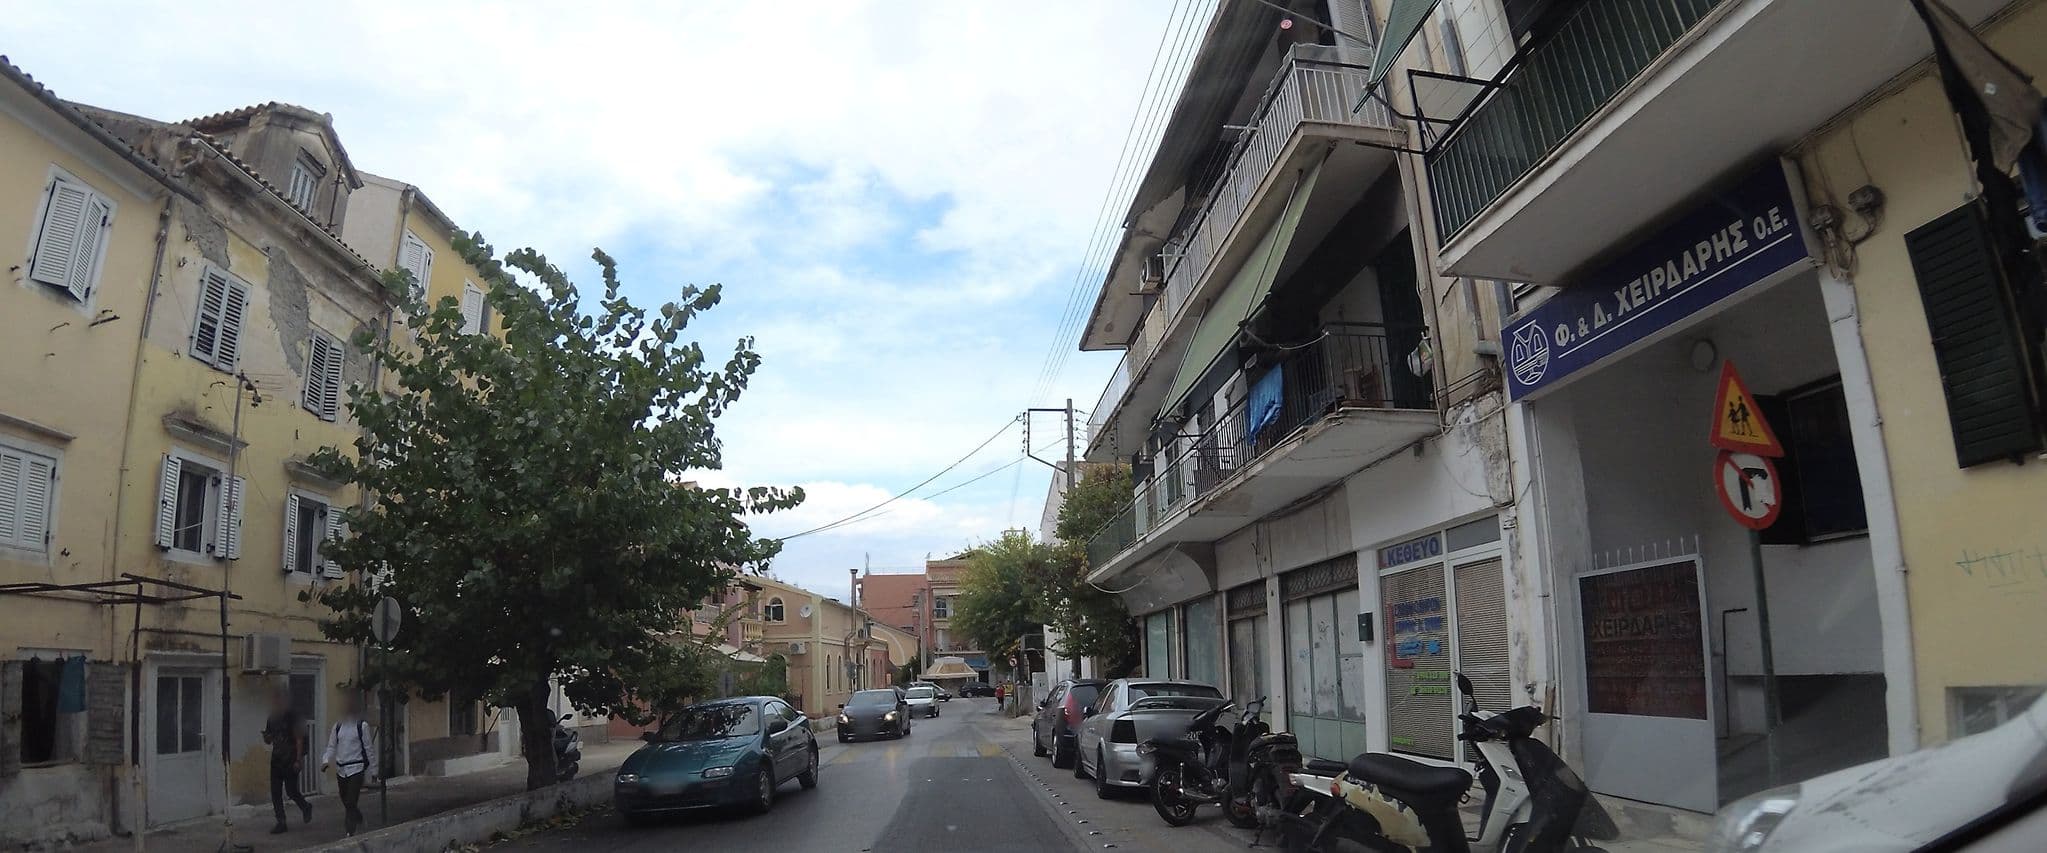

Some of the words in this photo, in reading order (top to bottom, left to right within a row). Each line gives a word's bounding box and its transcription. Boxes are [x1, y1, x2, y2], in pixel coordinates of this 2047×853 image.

[1554, 323, 1576, 348] Φ.
[1577, 316, 1590, 337] &
[1593, 302, 1613, 330] Δ.
[1613, 219, 1749, 317] ΧΕΙΡΔΑΡΗΣ
[1753, 206, 1790, 241] Ο.Ε.
